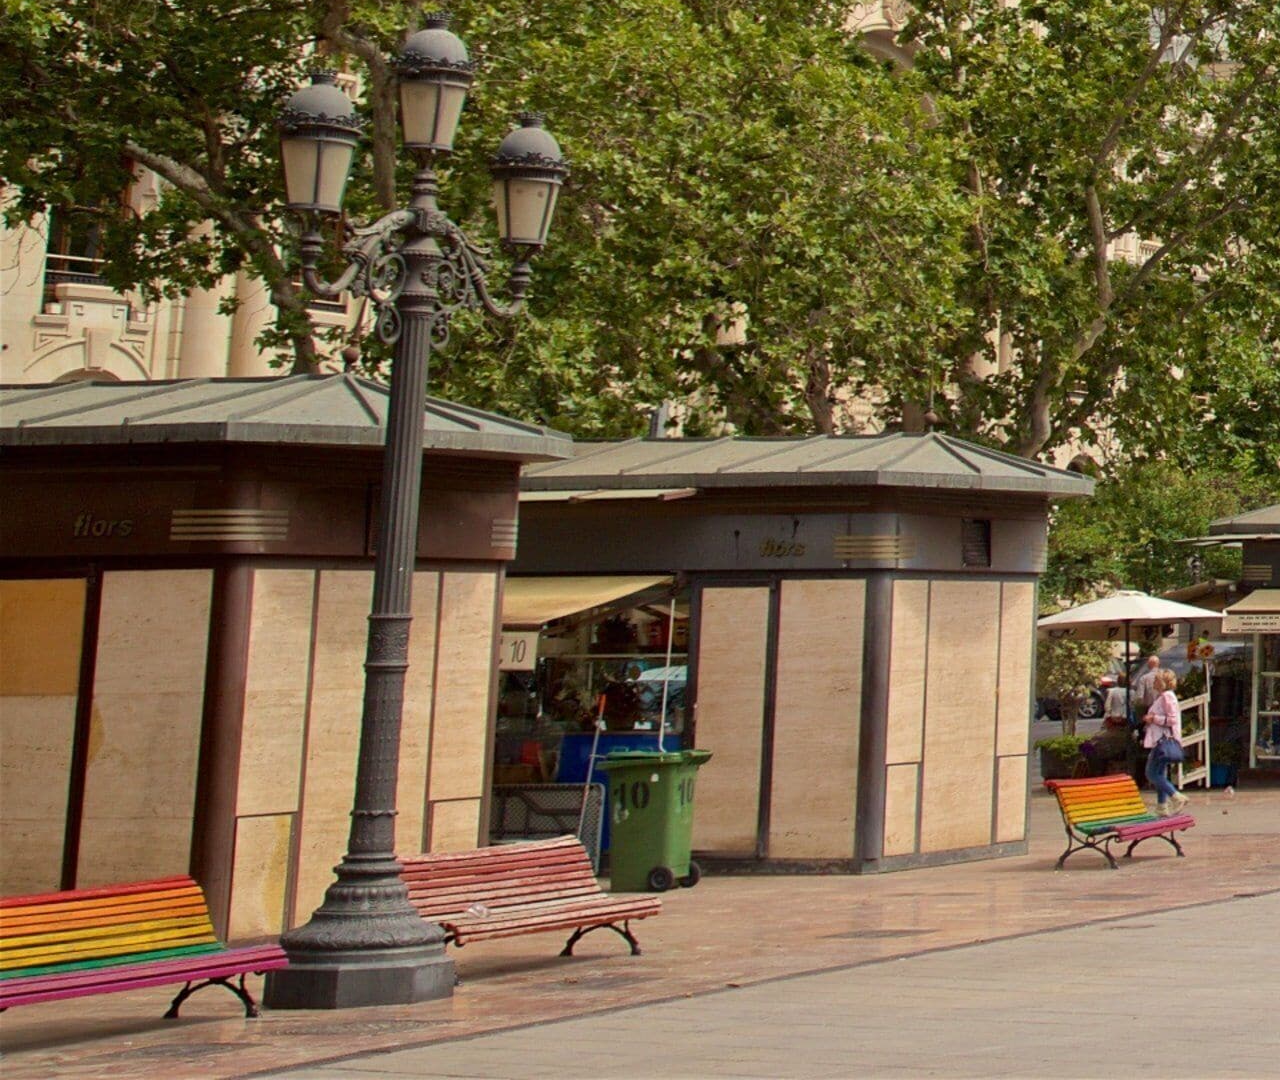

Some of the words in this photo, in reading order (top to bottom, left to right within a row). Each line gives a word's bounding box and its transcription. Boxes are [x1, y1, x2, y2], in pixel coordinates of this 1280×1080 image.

[73, 511, 133, 537] flors
[511, 640, 526, 663] 10
[614, 781, 650, 811] 10
